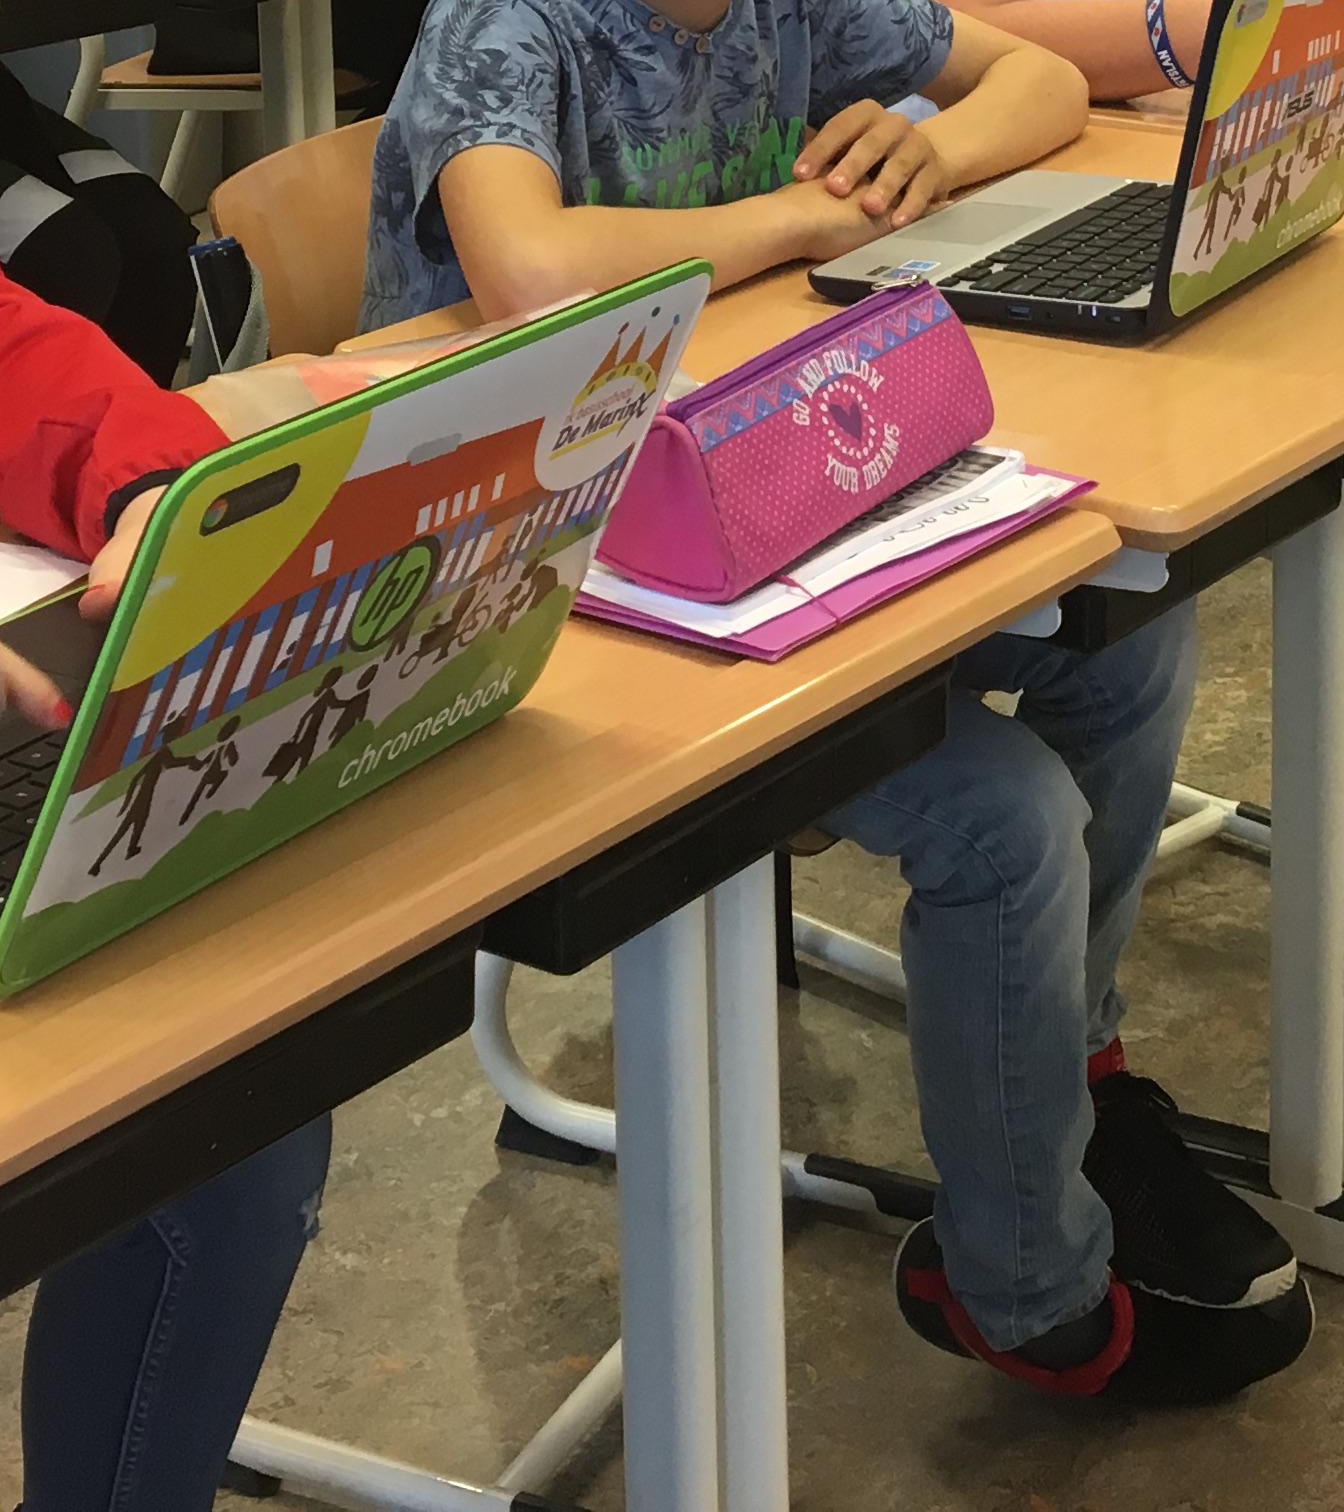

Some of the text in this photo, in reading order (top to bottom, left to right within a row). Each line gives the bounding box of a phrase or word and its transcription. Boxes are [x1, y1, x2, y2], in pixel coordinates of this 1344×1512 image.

[797, 349, 885, 399] AND FOLLOW
[551, 424, 581, 452] De
[792, 398, 811, 426] GO
[824, 422, 900, 496] YOUR DREAMS
[358, 548, 425, 644] hp
[337, 664, 517, 789] chromebook
